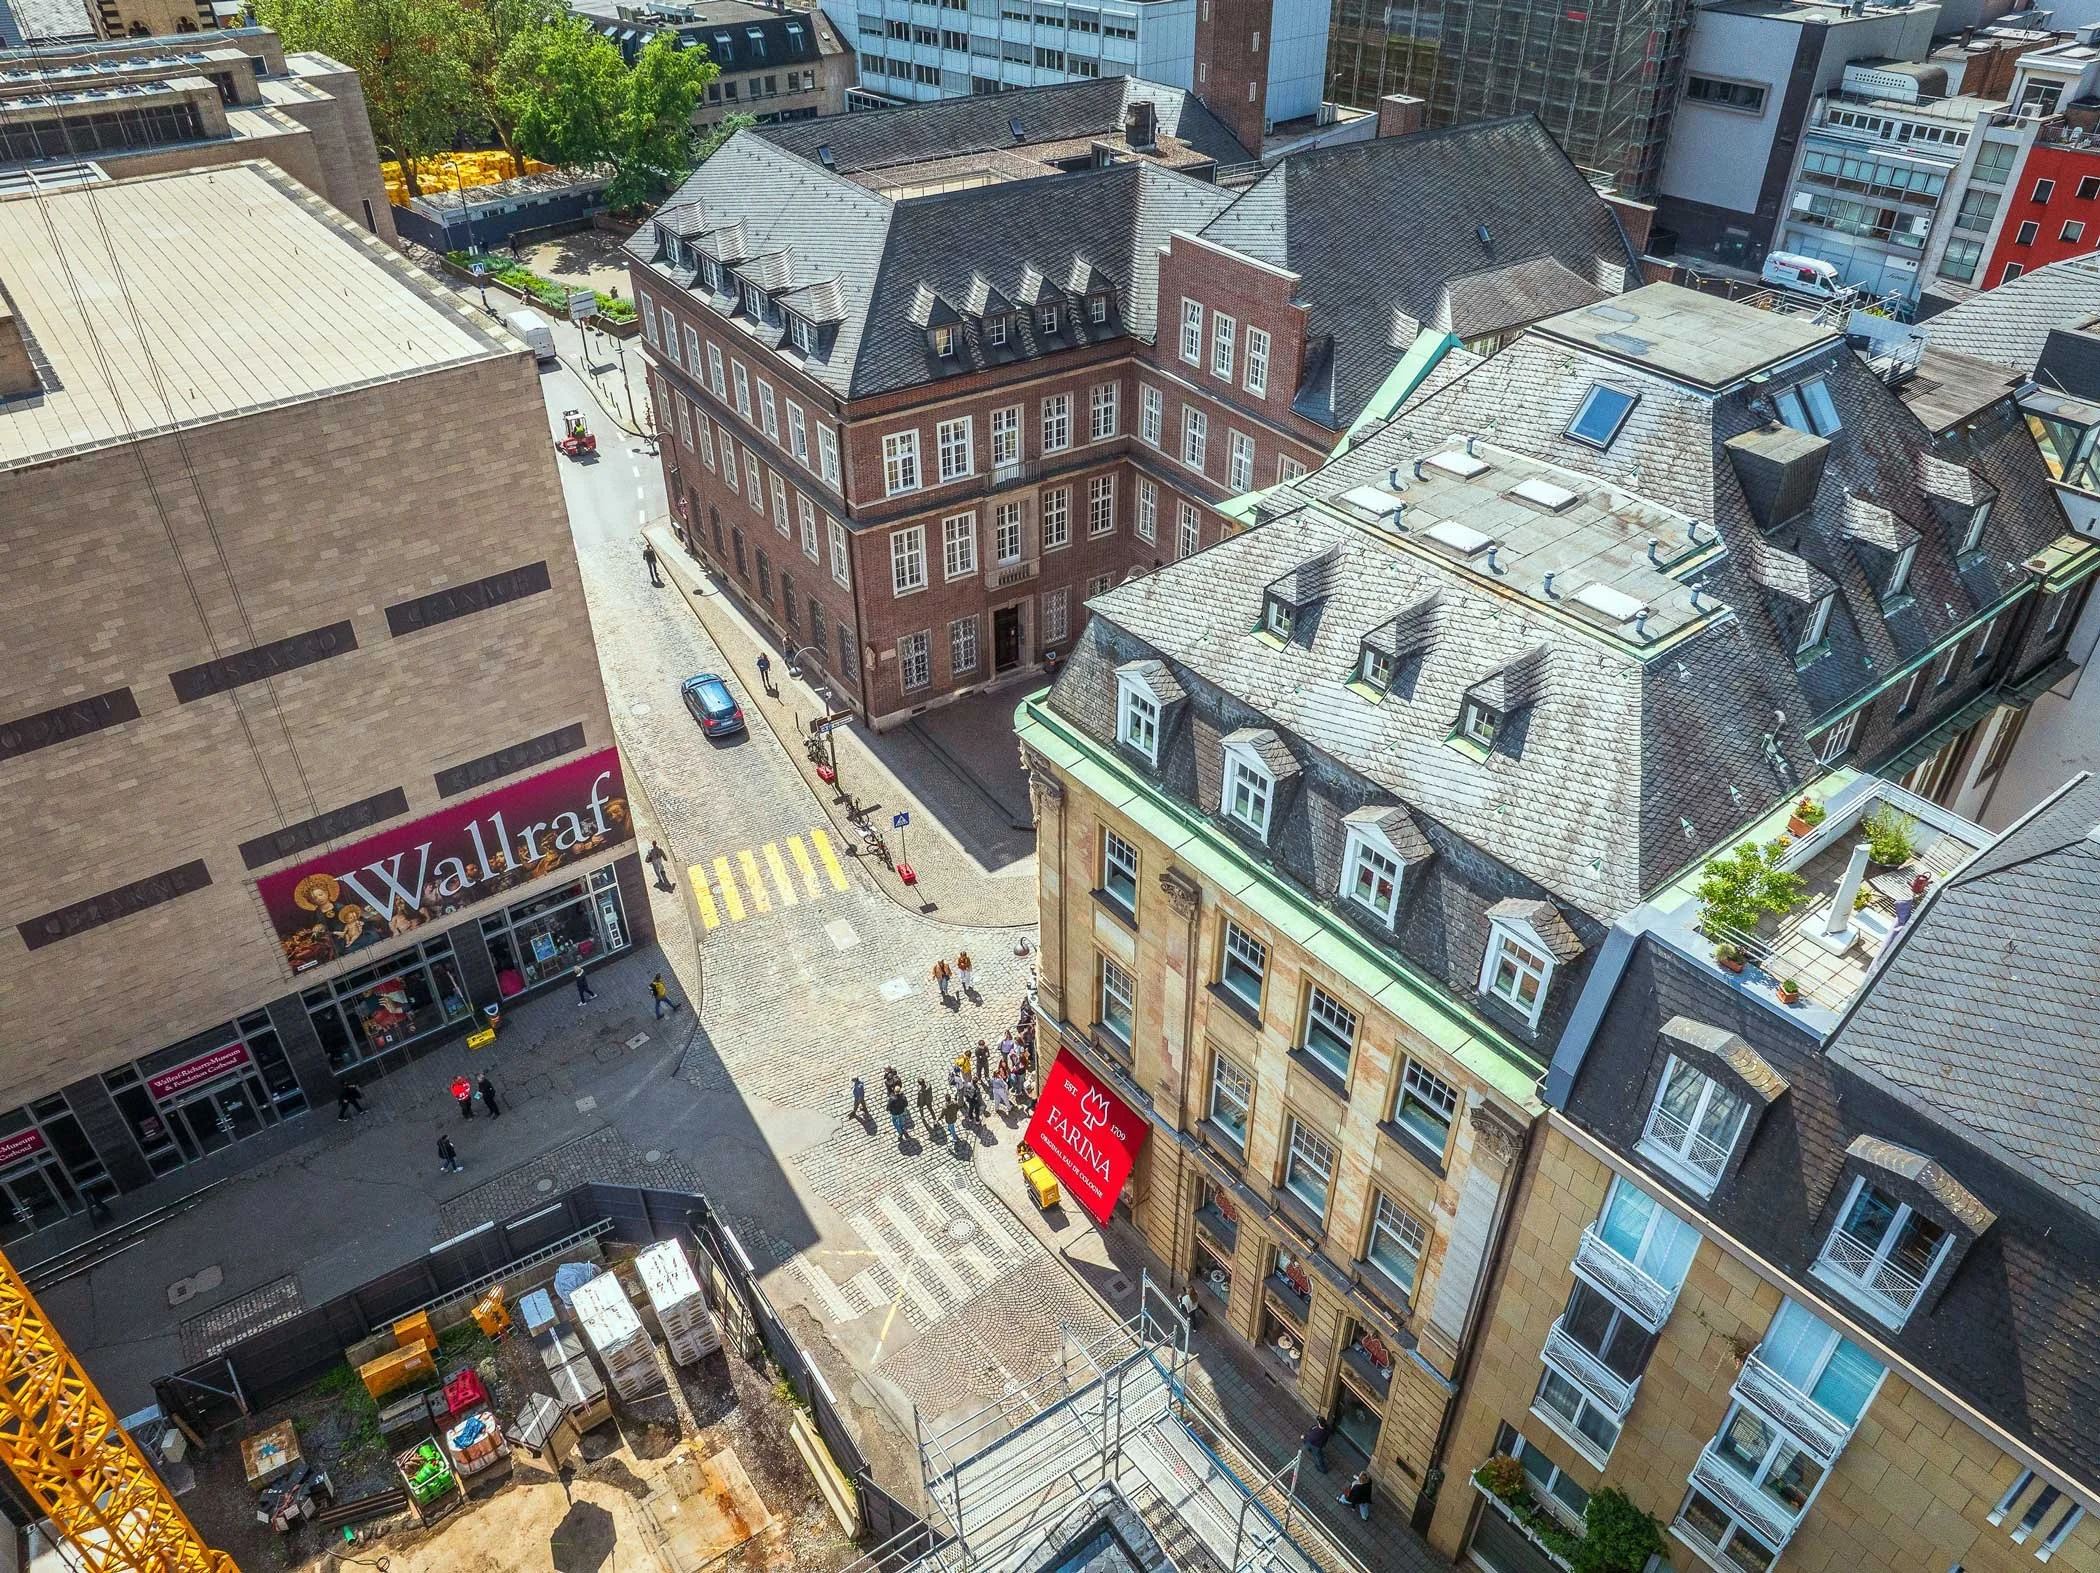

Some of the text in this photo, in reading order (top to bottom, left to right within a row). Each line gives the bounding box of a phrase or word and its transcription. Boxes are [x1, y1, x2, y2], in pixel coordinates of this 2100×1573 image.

[335, 771, 611, 921] Wallraf
[173, 1071, 208, 1088] Fondation
[1064, 1079, 1079, 1097] EST.
[1046, 1106, 1111, 1183] FARINA
[1110, 1125, 1126, 1141] 1709
[1040, 1133, 1104, 1199] ORIGINAL EAU DE COLOGNE
